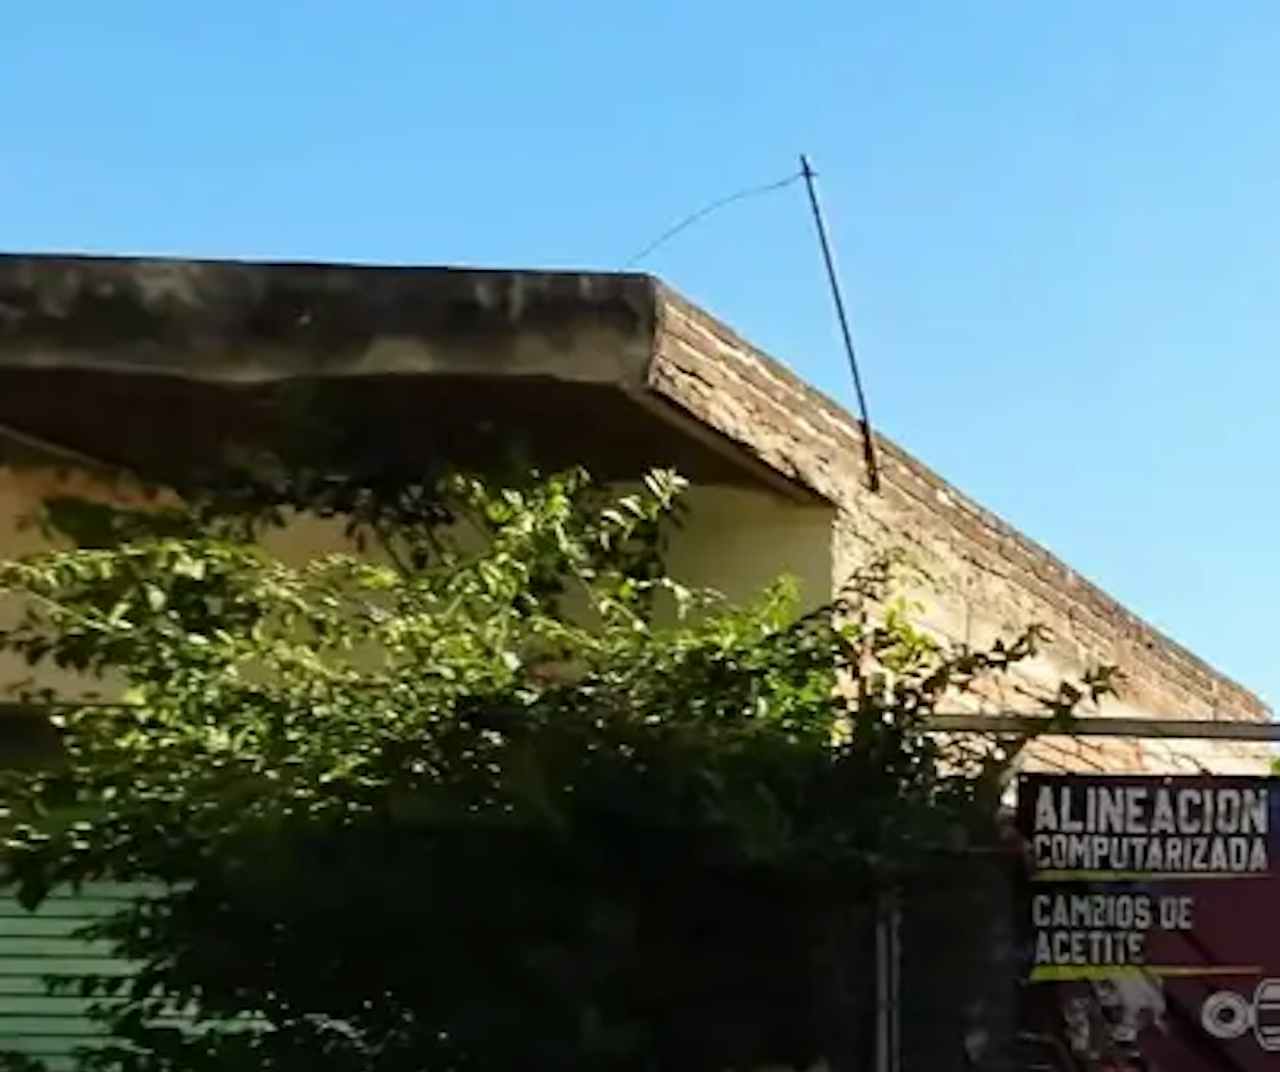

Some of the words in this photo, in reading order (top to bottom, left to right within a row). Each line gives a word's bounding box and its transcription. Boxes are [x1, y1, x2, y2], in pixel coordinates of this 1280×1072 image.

[1034, 784, 1270, 835] ALINEACION
[1034, 833, 1269, 872] COMPUTARIZADA
[1158, 896, 1194, 930] DE
